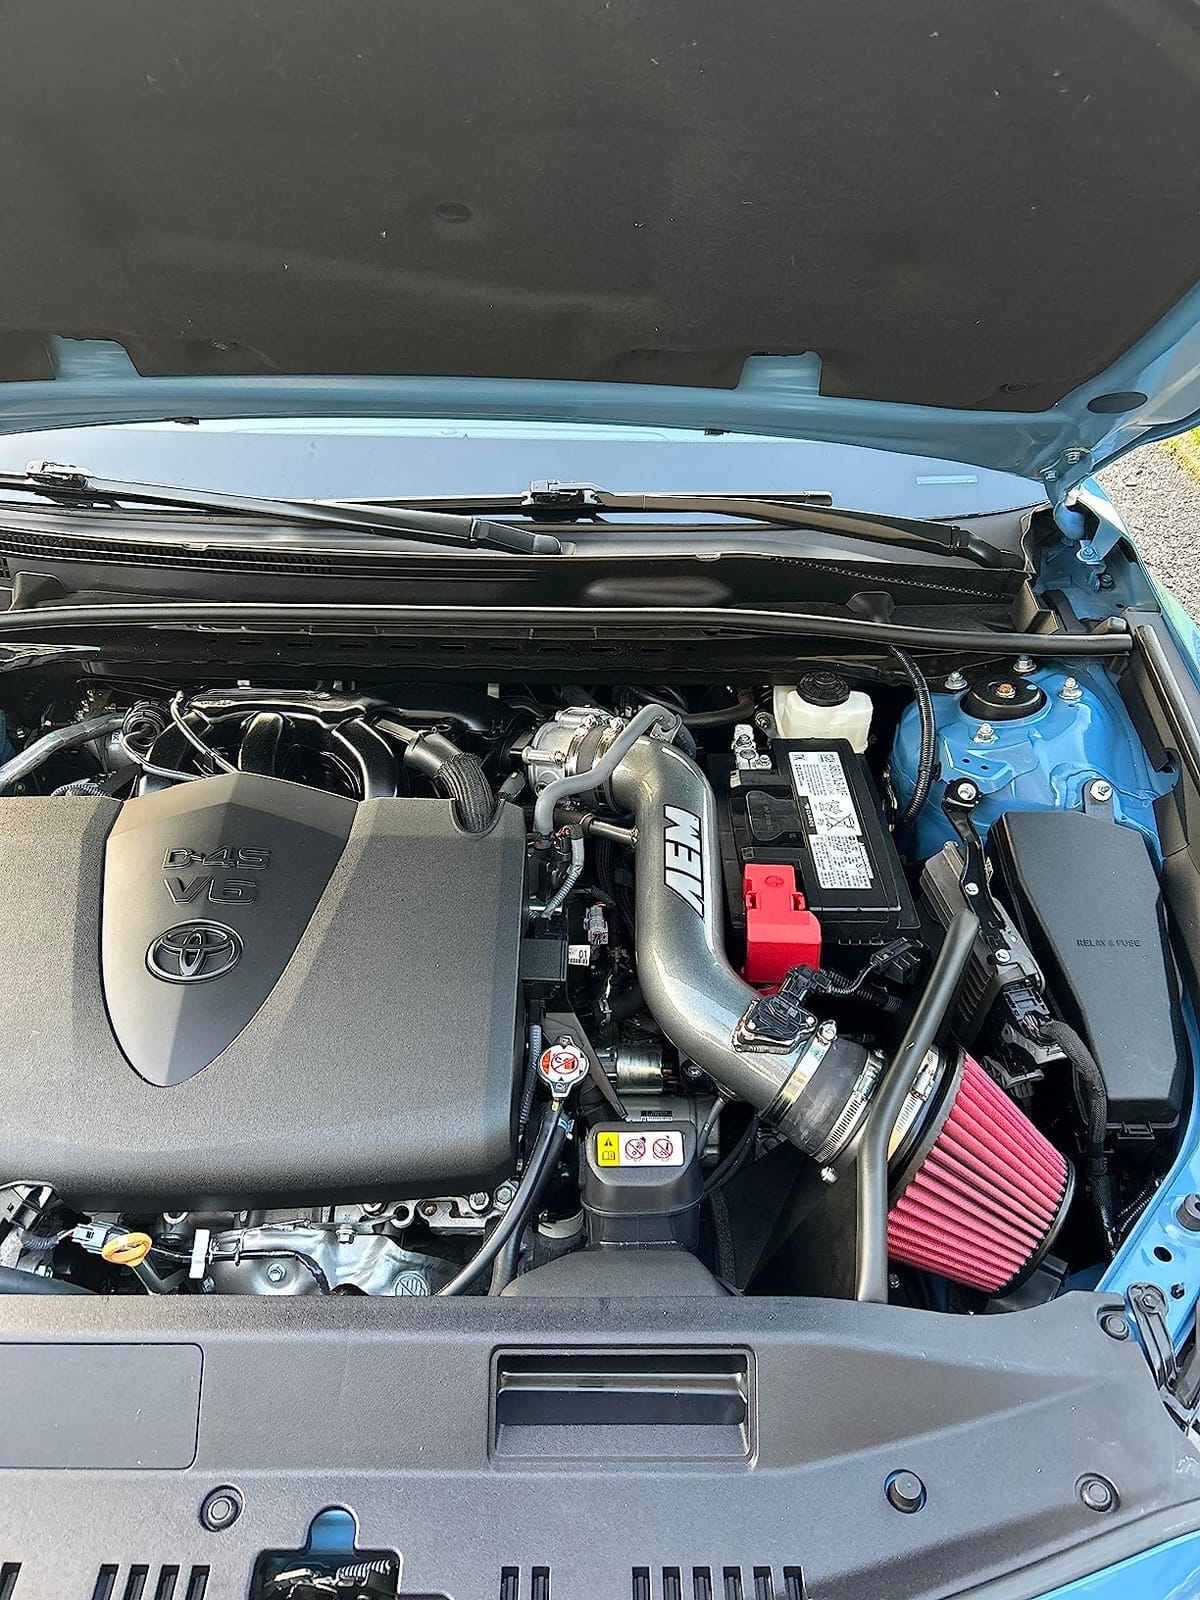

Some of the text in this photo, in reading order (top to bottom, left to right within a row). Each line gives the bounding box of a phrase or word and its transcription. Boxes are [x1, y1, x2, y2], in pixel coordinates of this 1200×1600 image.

[162, 846, 272, 870] D-4S
[663, 804, 704, 919] AEM
[163, 875, 257, 905] V6
[1076, 939, 1106, 947] RELAY
[1116, 939, 1141, 947] FUSE
